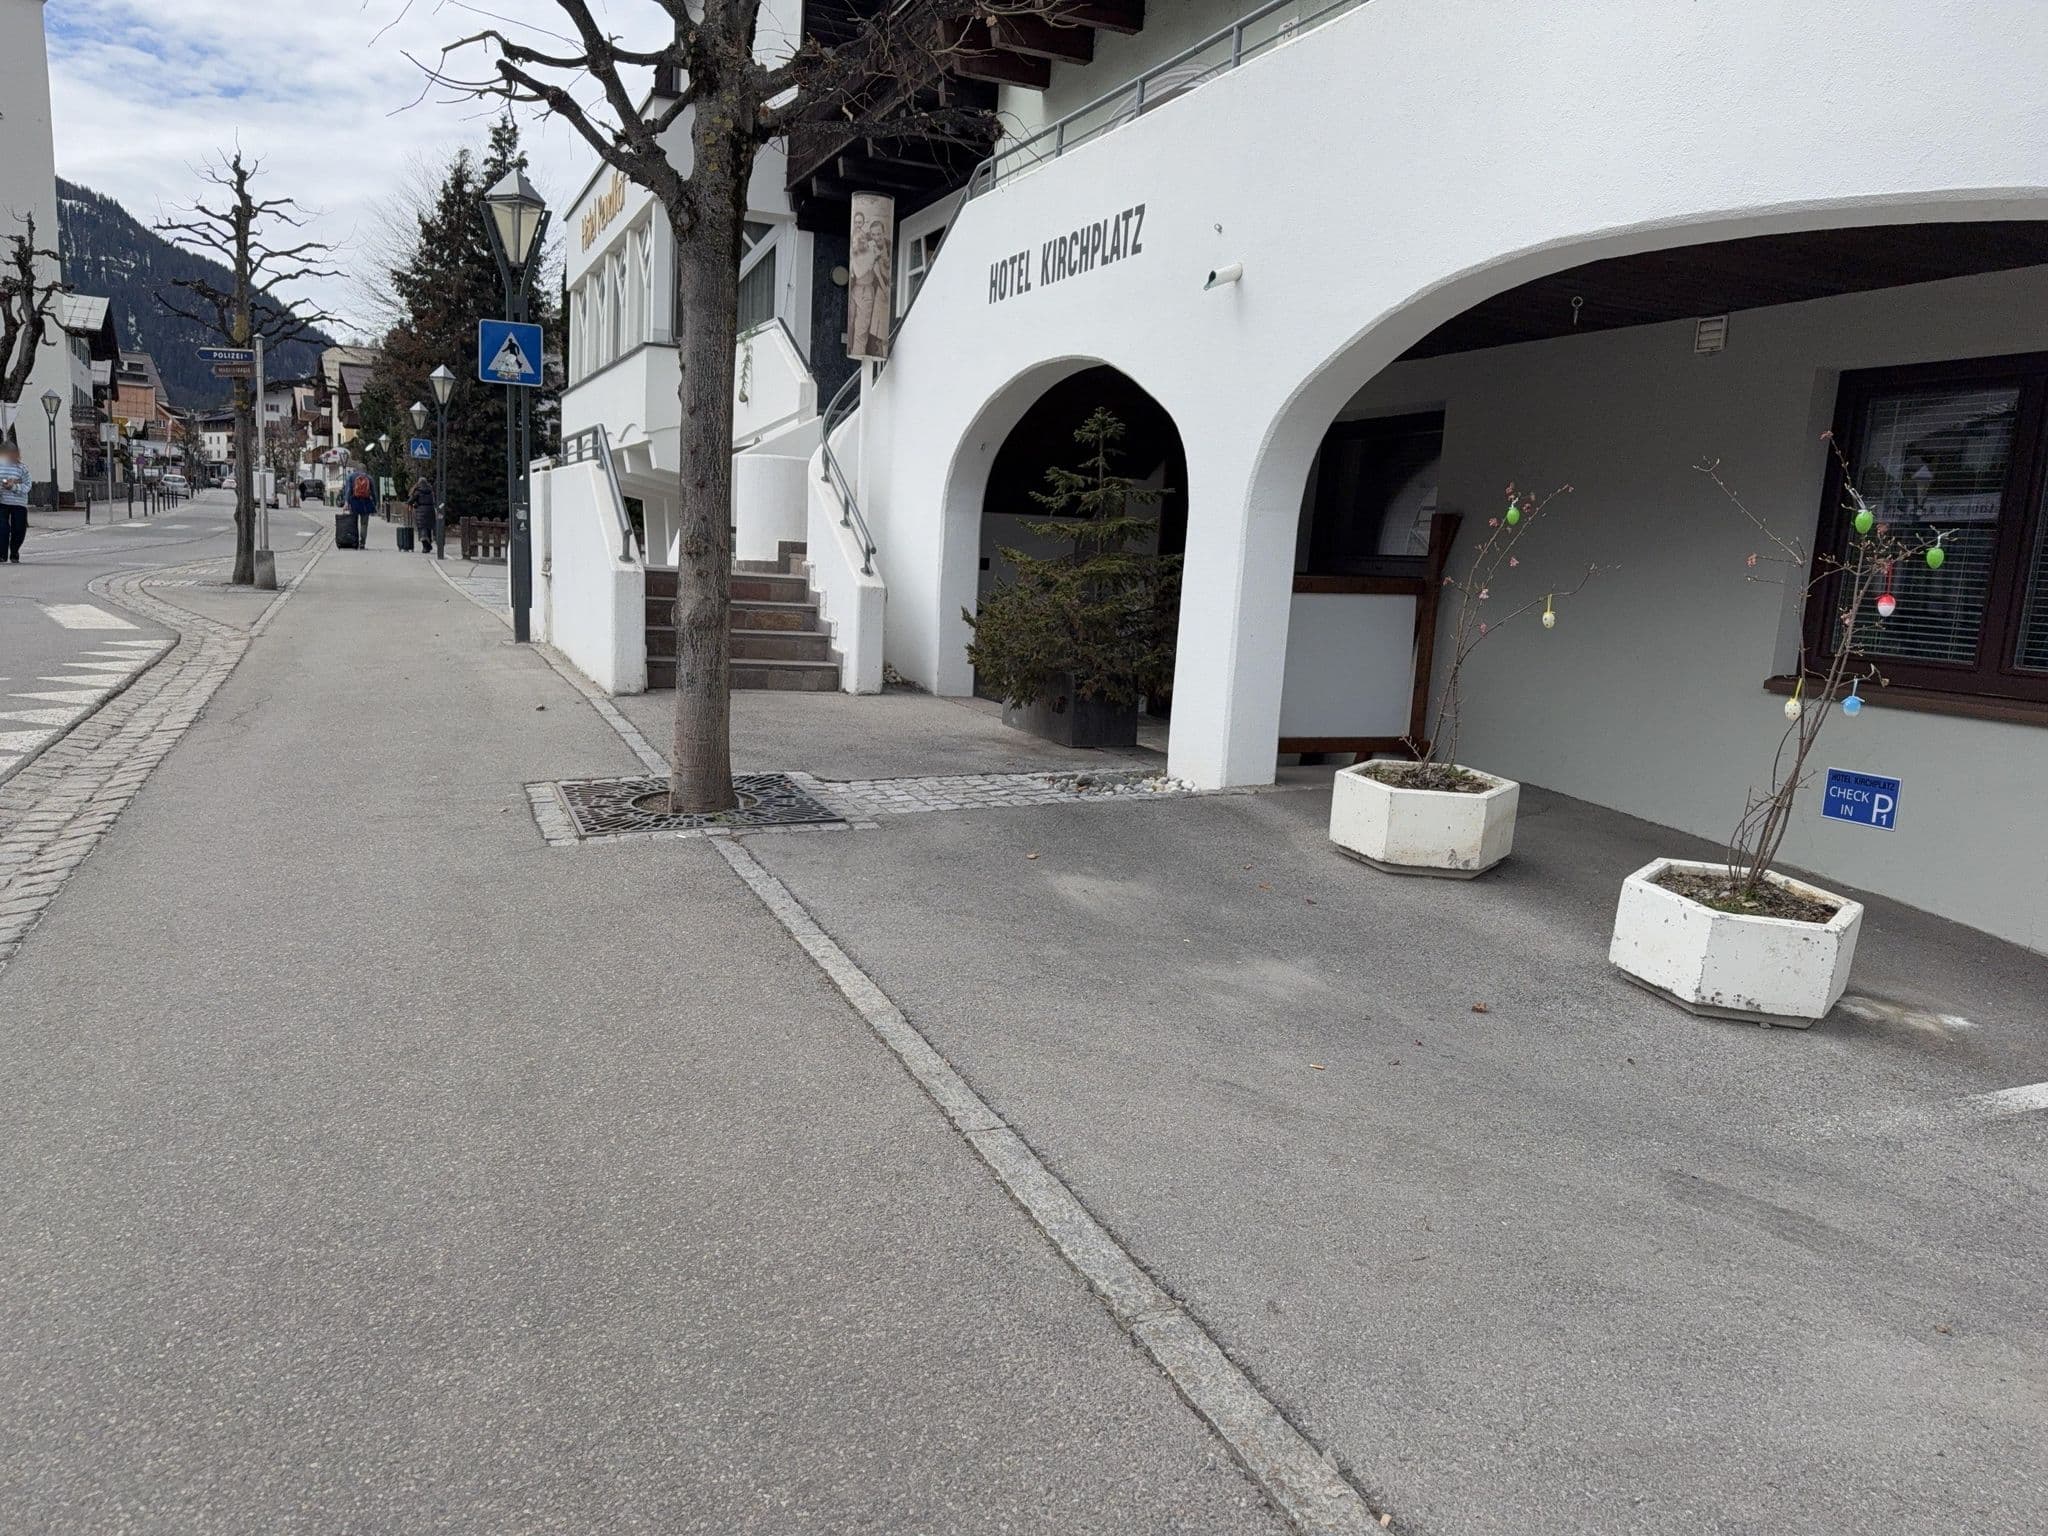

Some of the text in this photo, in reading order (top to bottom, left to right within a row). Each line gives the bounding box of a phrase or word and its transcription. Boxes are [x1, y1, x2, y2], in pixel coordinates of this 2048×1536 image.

[988, 203, 1146, 305] HOTEL KIRCHPLATZ
[213, 351, 243, 360] POLIZEI
[1829, 785, 1870, 803] CHECK
[1840, 803, 1853, 817] IN
